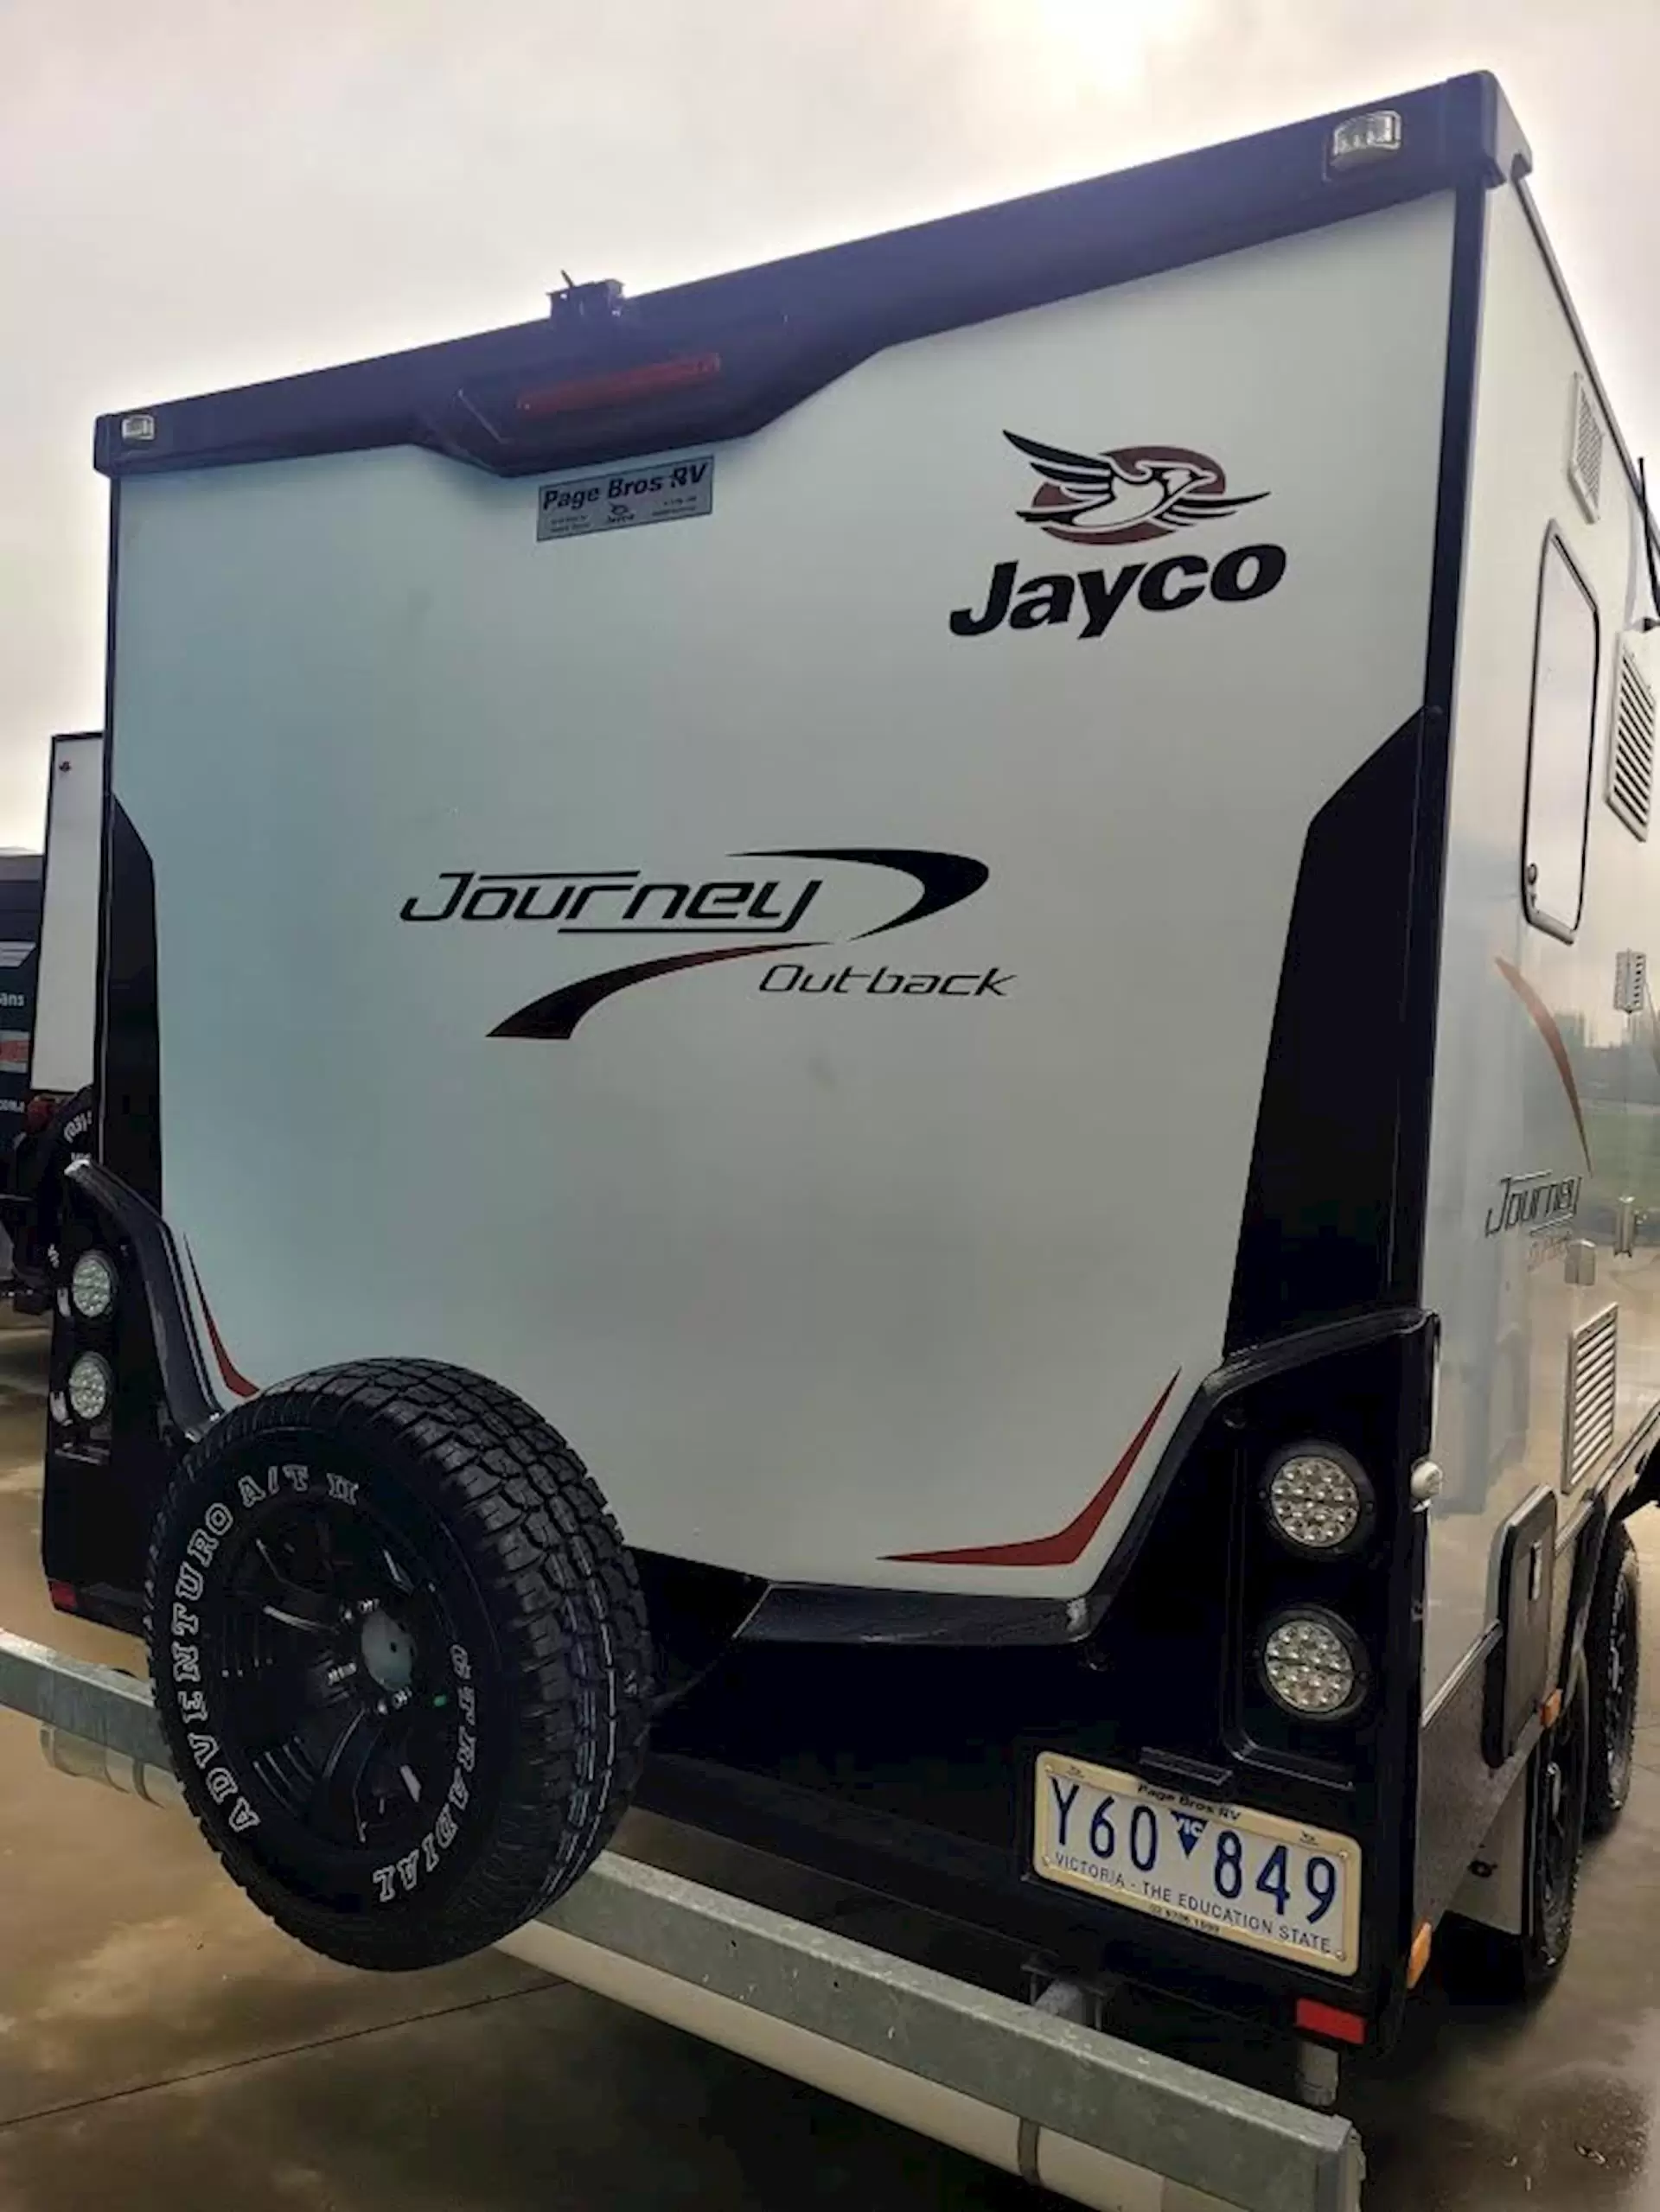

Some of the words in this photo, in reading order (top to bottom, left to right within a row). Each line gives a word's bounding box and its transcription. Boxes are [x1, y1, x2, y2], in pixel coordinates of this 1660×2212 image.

[544, 488, 599, 510] Page
[608, 477, 662, 498] Bros
[671, 462, 708, 488] RV
[949, 544, 1286, 639] Jayco
[400, 870, 822, 934] Journey
[759, 964, 1018, 997] Outback
[172, 1502, 260, 1833] ADVENTURO
[1051, 1778, 1158, 1872] Y60
[1214, 1829, 1336, 1924] 849
[1055, 1852, 1126, 1889] VICTORIA
[1143, 1883, 1172, 1903] THE
[1178, 1891, 1272, 1935] EDUCATION
[1279, 1923, 1332, 1954] STATE
